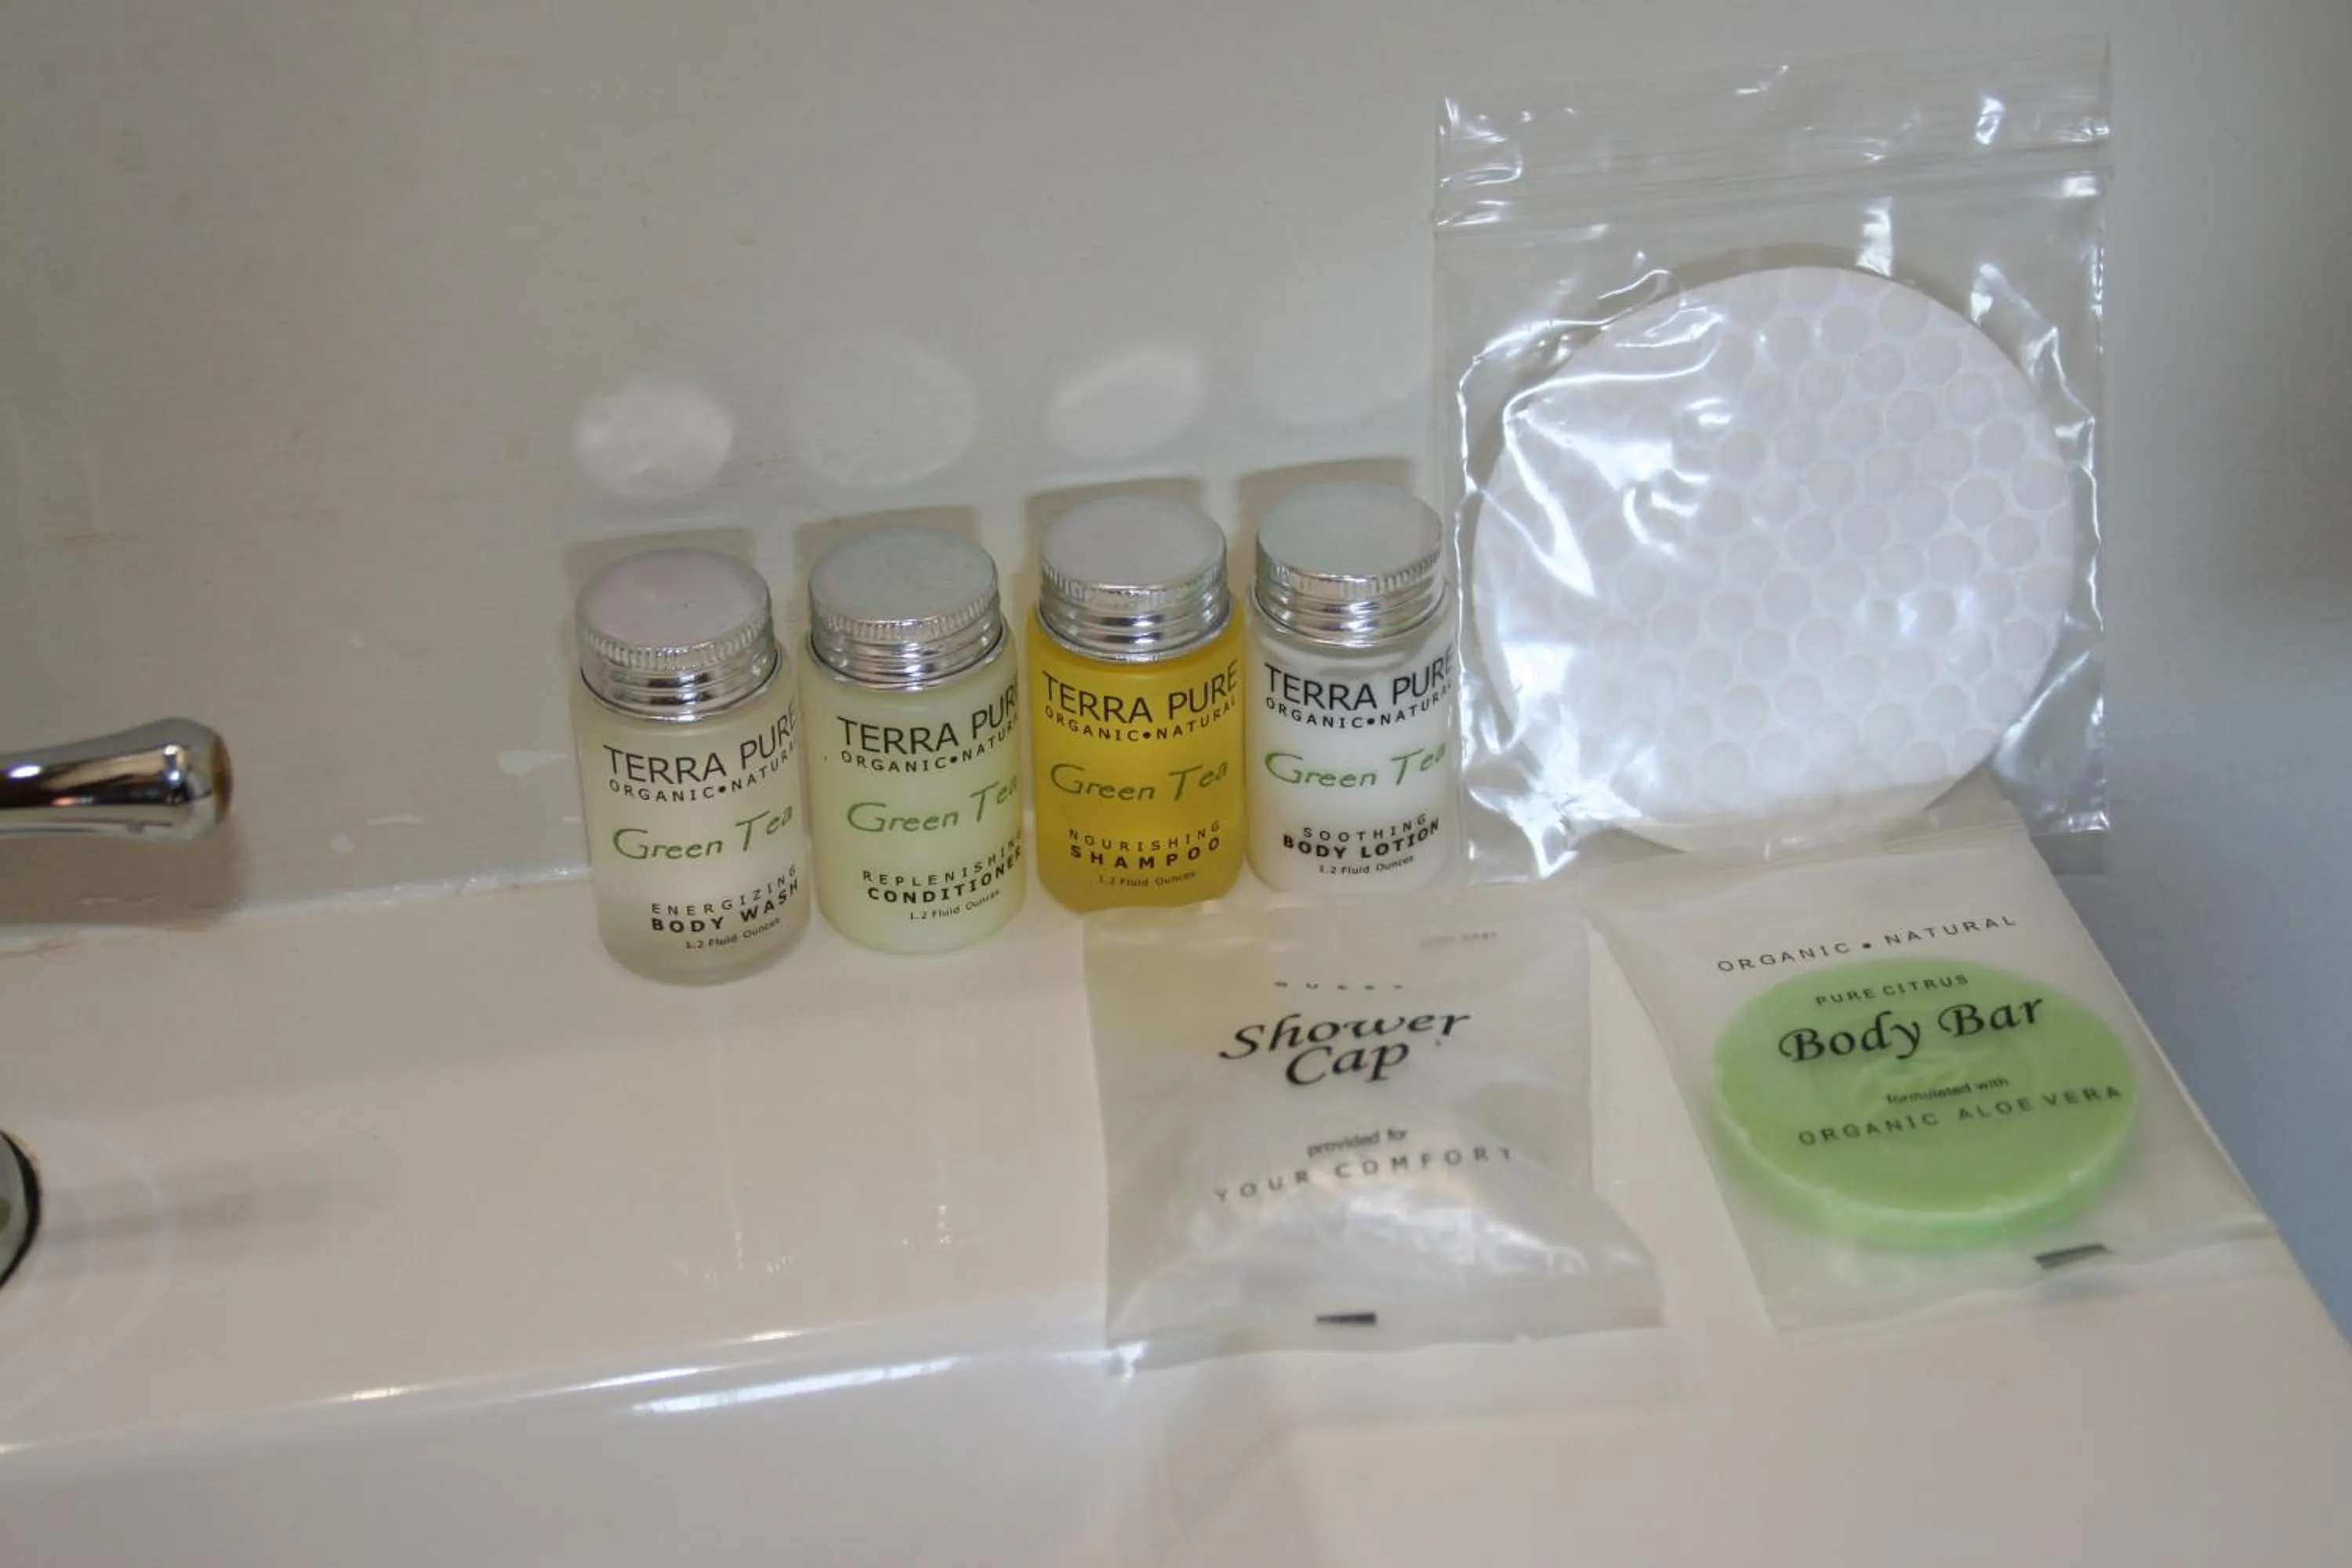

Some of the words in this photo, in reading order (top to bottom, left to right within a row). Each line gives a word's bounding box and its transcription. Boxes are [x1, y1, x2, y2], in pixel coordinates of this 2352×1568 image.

[1042, 670, 1153, 724] TERRA
[1168, 659, 1237, 720] PURE
[1265, 662, 1377, 711] TERRA
[1392, 643, 1453, 706] PURE
[837, 716, 960, 755] TERRA
[603, 744, 727, 784] TERRA
[1051, 763, 1156, 800] Green
[1168, 761, 1228, 801] Tea
[1265, 752, 1377, 788] Green
[1392, 742, 1446, 786] Tea
[847, 802, 959, 833] Green
[969, 775, 1018, 822] Tea
[612, 828, 724, 860] Green
[735, 805, 793, 851] Tea
[1069, 820, 1220, 852] NOURISHING
[1283, 834, 1347, 859] BODY
[1361, 818, 1439, 858] LOTION
[1304, 813, 1426, 842] SOOTHING
[1069, 837, 1220, 869] SHAMPOO
[1341, 866, 1370, 875] Fluid
[652, 864, 796, 916] ENERGIZING
[652, 916, 724, 933] BODY
[740, 877, 797, 922] WASH
[1717, 942, 1850, 972] ORGANIC
[1885, 915, 2017, 946] NATURAL
[1815, 988, 1877, 1007] PURE
[1882, 974, 1969, 996] CITRUS
[1218, 1013, 1472, 1060] Shower
[1778, 1011, 1921, 1062] Body
[1937, 997, 2044, 1037] Bar
[1286, 1041, 1410, 1086] Cap
[1798, 1112, 1940, 1146] ORGANIC
[1959, 1099, 2033, 1121] ALOE
[2042, 1084, 2123, 1107] VERA
[1307, 1131, 1380, 1158] provided
[1216, 1170, 1309, 1203] YOUR
[1335, 1146, 1512, 1178] COMFORT
